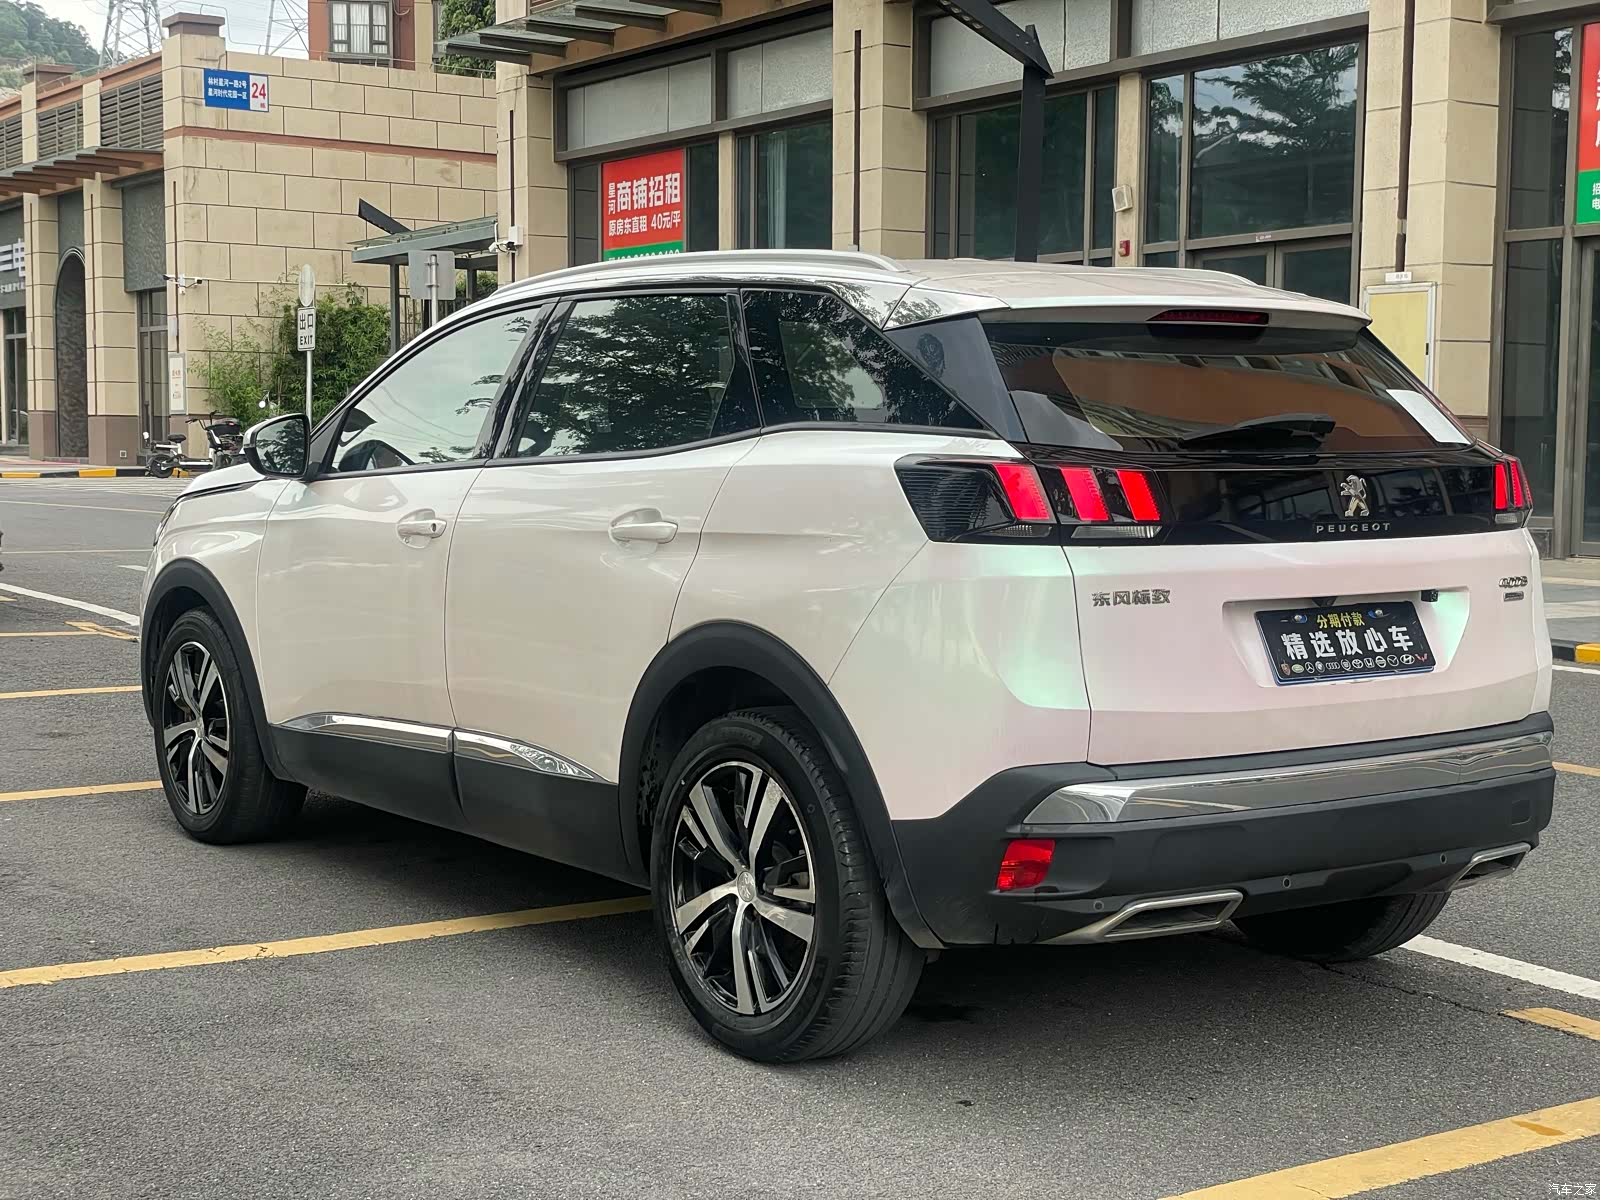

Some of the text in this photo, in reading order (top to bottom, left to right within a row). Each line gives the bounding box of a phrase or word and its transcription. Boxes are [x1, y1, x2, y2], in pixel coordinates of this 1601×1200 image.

[251, 82, 267, 100] 24
[616, 172, 681, 213] 商铺招租
[608, 210, 682, 237] 原房东直租 40元/平
[299, 313, 314, 330] 出口
[299, 335, 313, 345] EXIT
[1316, 522, 1391, 534] PEUGEOT
[1091, 588, 1171, 607] 东风标致
[1316, 611, 1366, 629] 分期付款
[1280, 625, 1415, 661] 精选放心车
